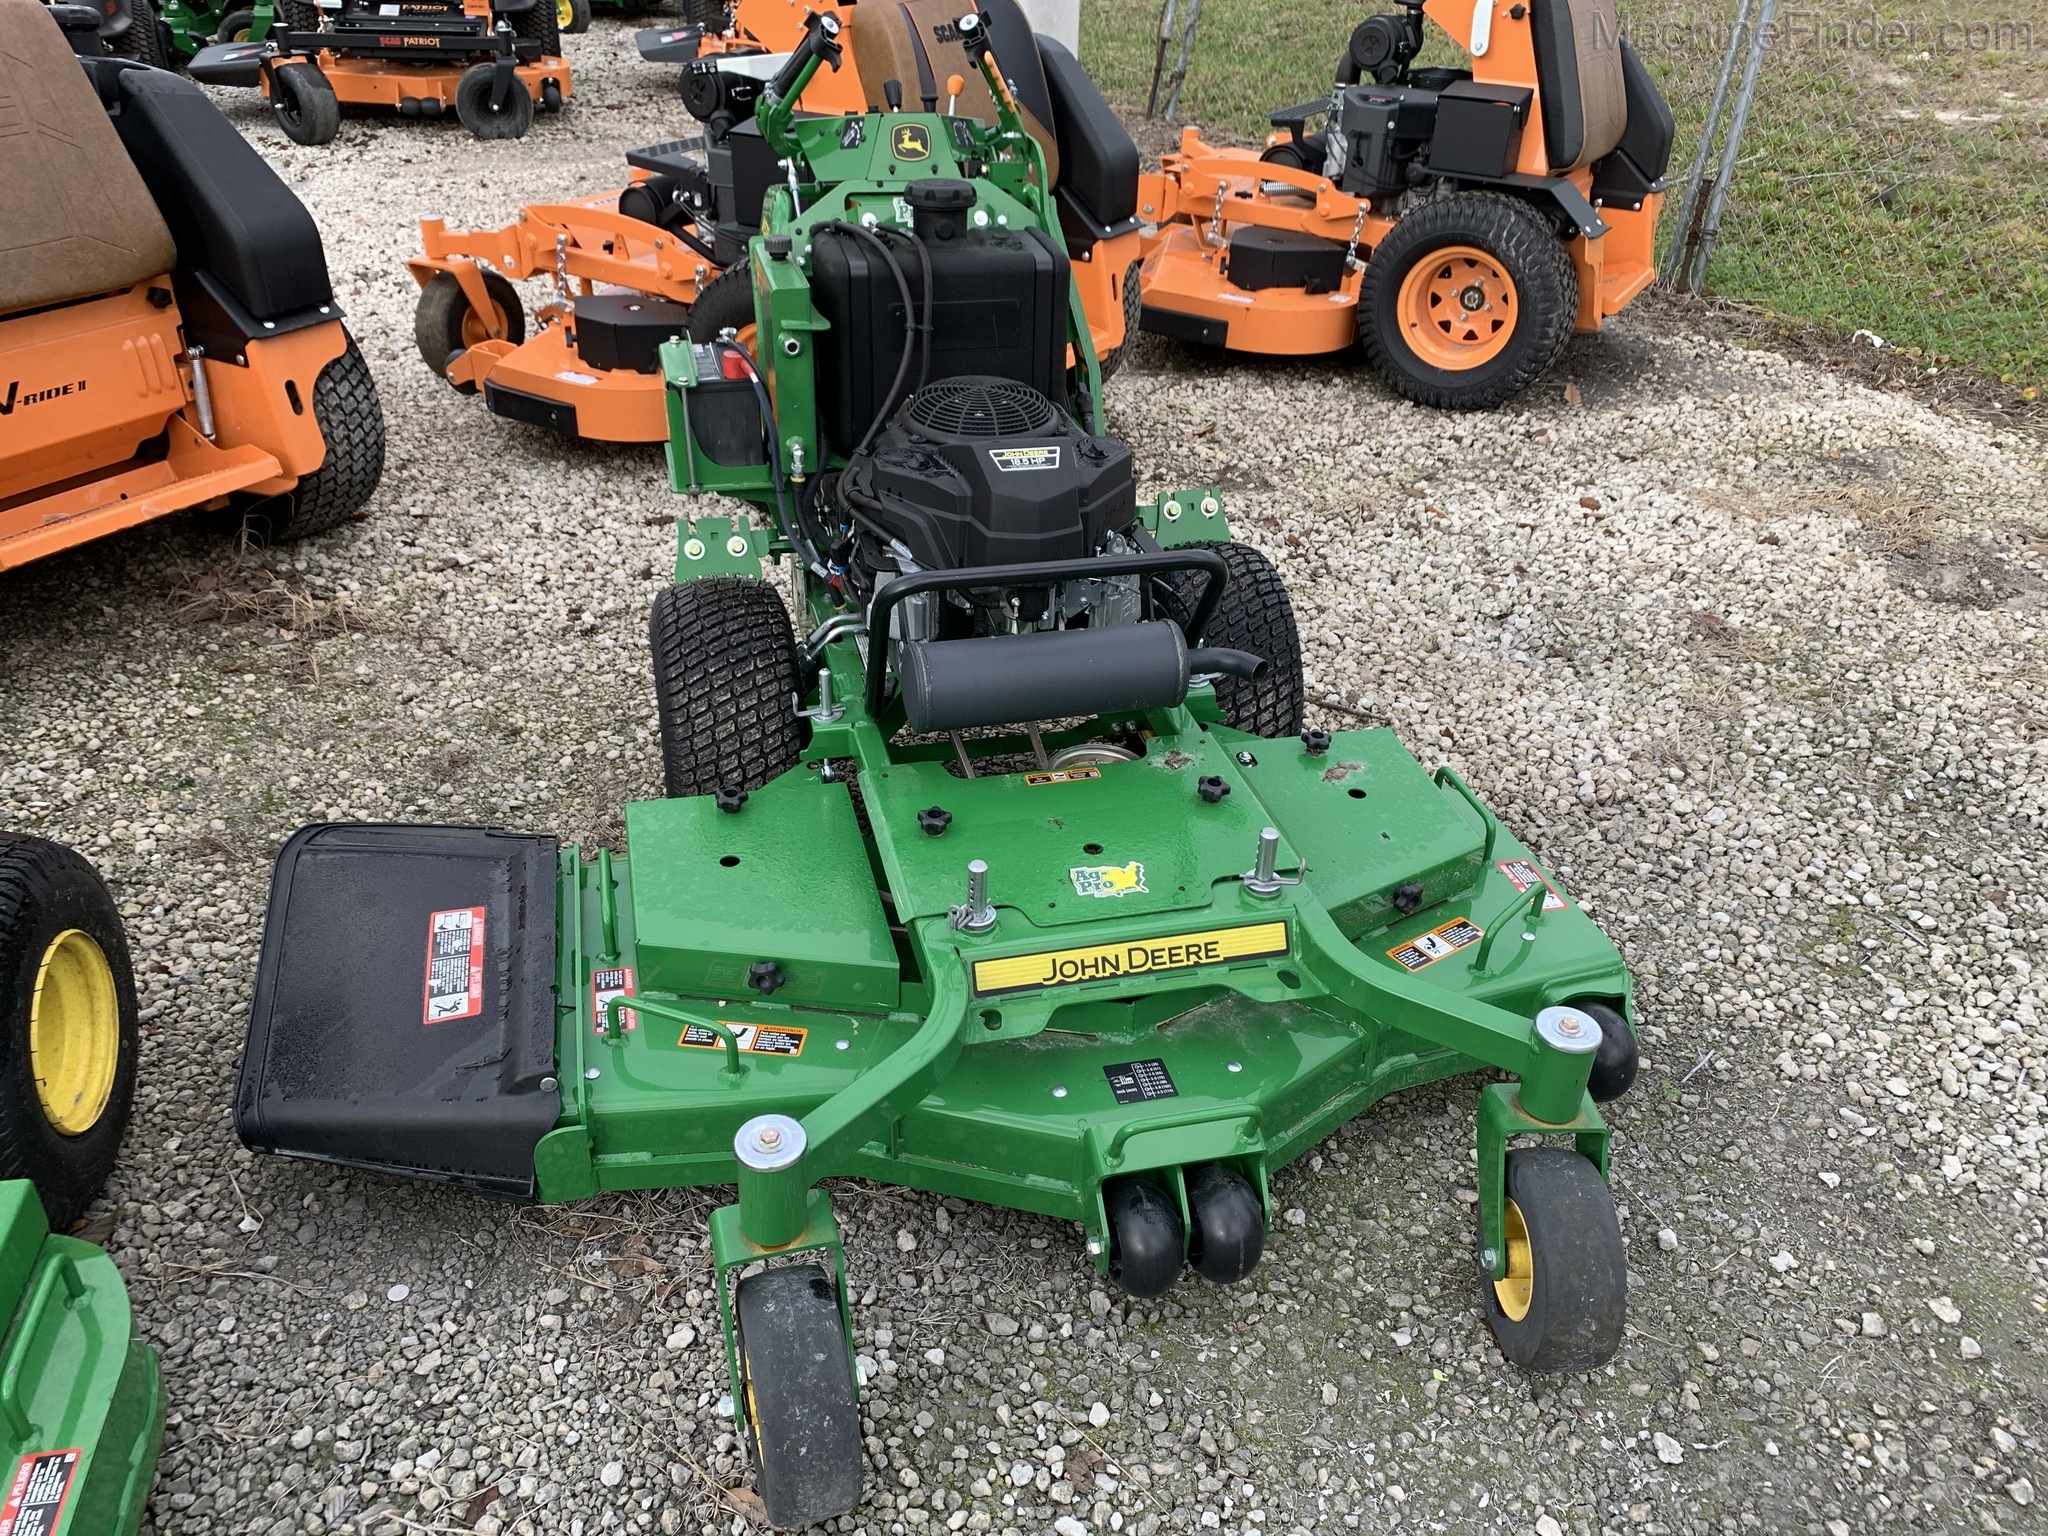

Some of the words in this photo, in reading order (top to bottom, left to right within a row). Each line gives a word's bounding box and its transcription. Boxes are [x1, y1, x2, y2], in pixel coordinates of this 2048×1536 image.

[403, 37, 440, 48] PATRIOT
[1010, 457, 1030, 466] 18.5
[1030, 457, 1046, 465] HP
[1079, 880, 1115, 893] Pro
[472, 924, 482, 946] DANGER
[1042, 953, 1122, 983] JOHN
[1127, 940, 1221, 970] DEERE
[470, 973, 480, 998] PELIGRO
[12, 1462, 32, 1496] PELIGRO
